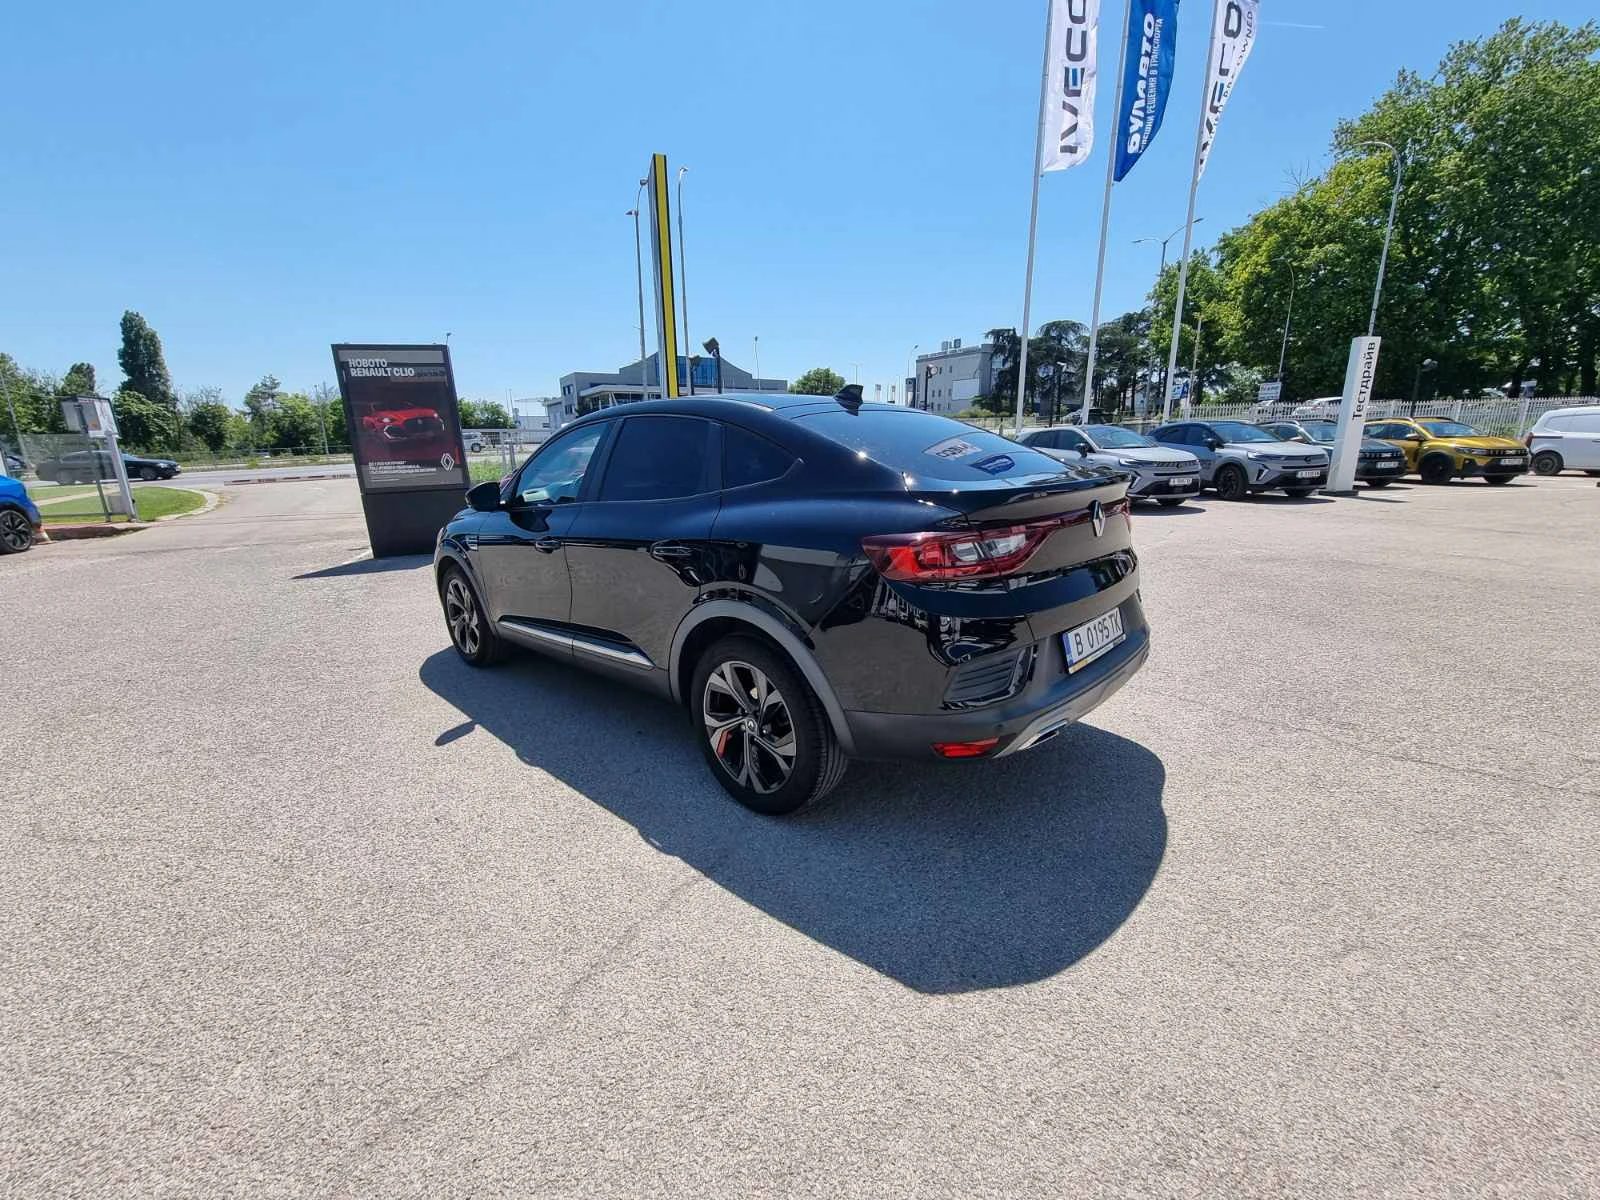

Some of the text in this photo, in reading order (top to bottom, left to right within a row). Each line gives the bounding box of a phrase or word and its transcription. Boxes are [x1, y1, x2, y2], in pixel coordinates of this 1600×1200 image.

[1150, 17, 1164, 68] ТРАНСПОРТА
[1060, 0, 1087, 154] IVECO
[1146, 77, 1158, 115] РЕШЕНИЯ
[348, 358, 387, 368] НОВОТО
[350, 367, 415, 377] RENAULT CLIO
[1352, 342, 1376, 420] Тестдрайв
[1074, 632, 1084, 656] B
[1087, 617, 1110, 648] 0195
